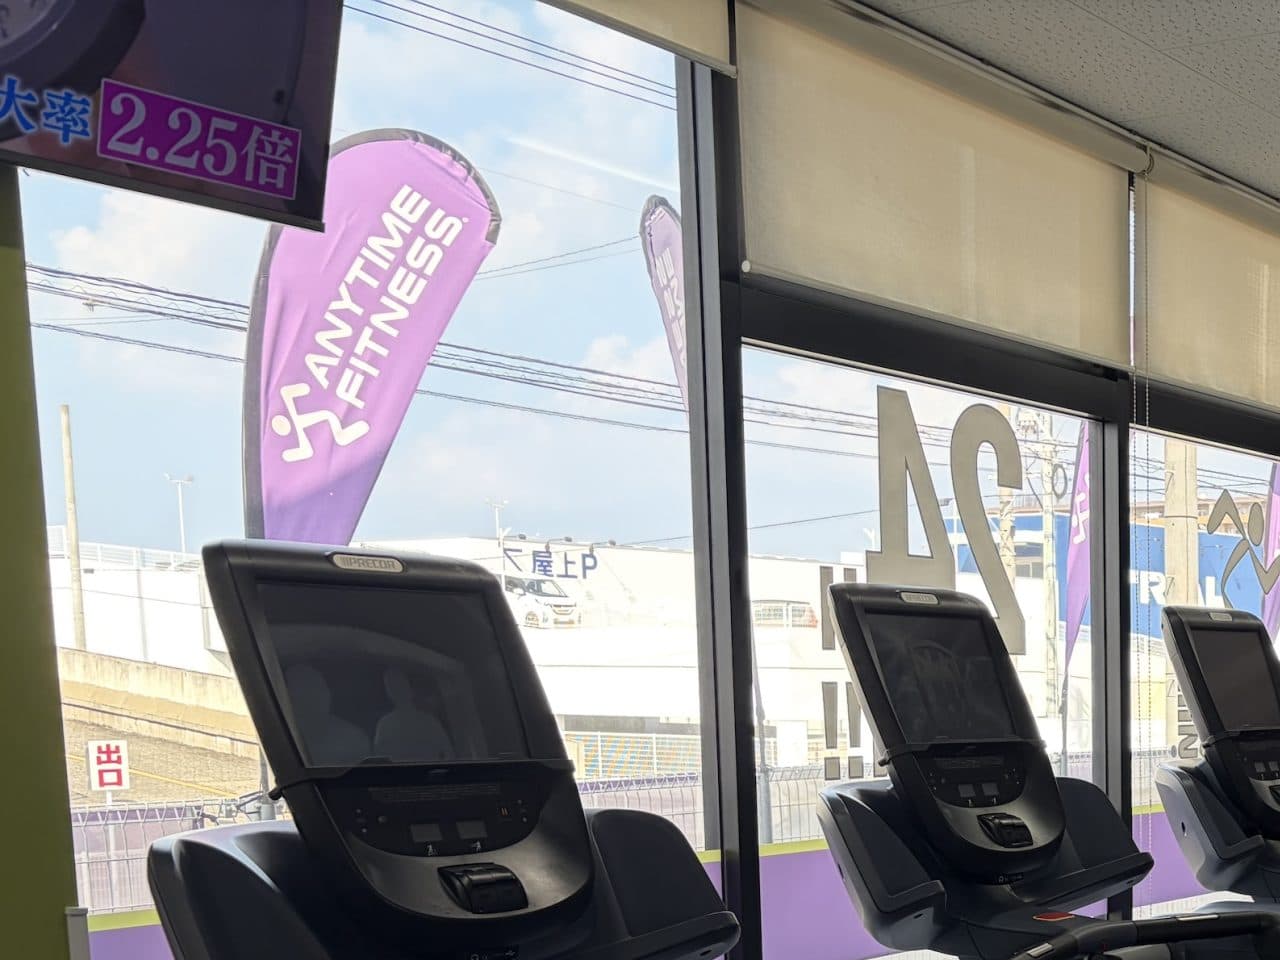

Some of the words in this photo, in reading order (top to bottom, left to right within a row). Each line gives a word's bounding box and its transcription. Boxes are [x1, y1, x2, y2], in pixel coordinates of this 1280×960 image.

[106, 92, 294, 189] 2.25倍
[305, 184, 431, 389] ANYTIME
[336, 207, 464, 410] FITNESS
[348, 556, 396, 570] PRECOR
[96, 743, 123, 788] 出口
